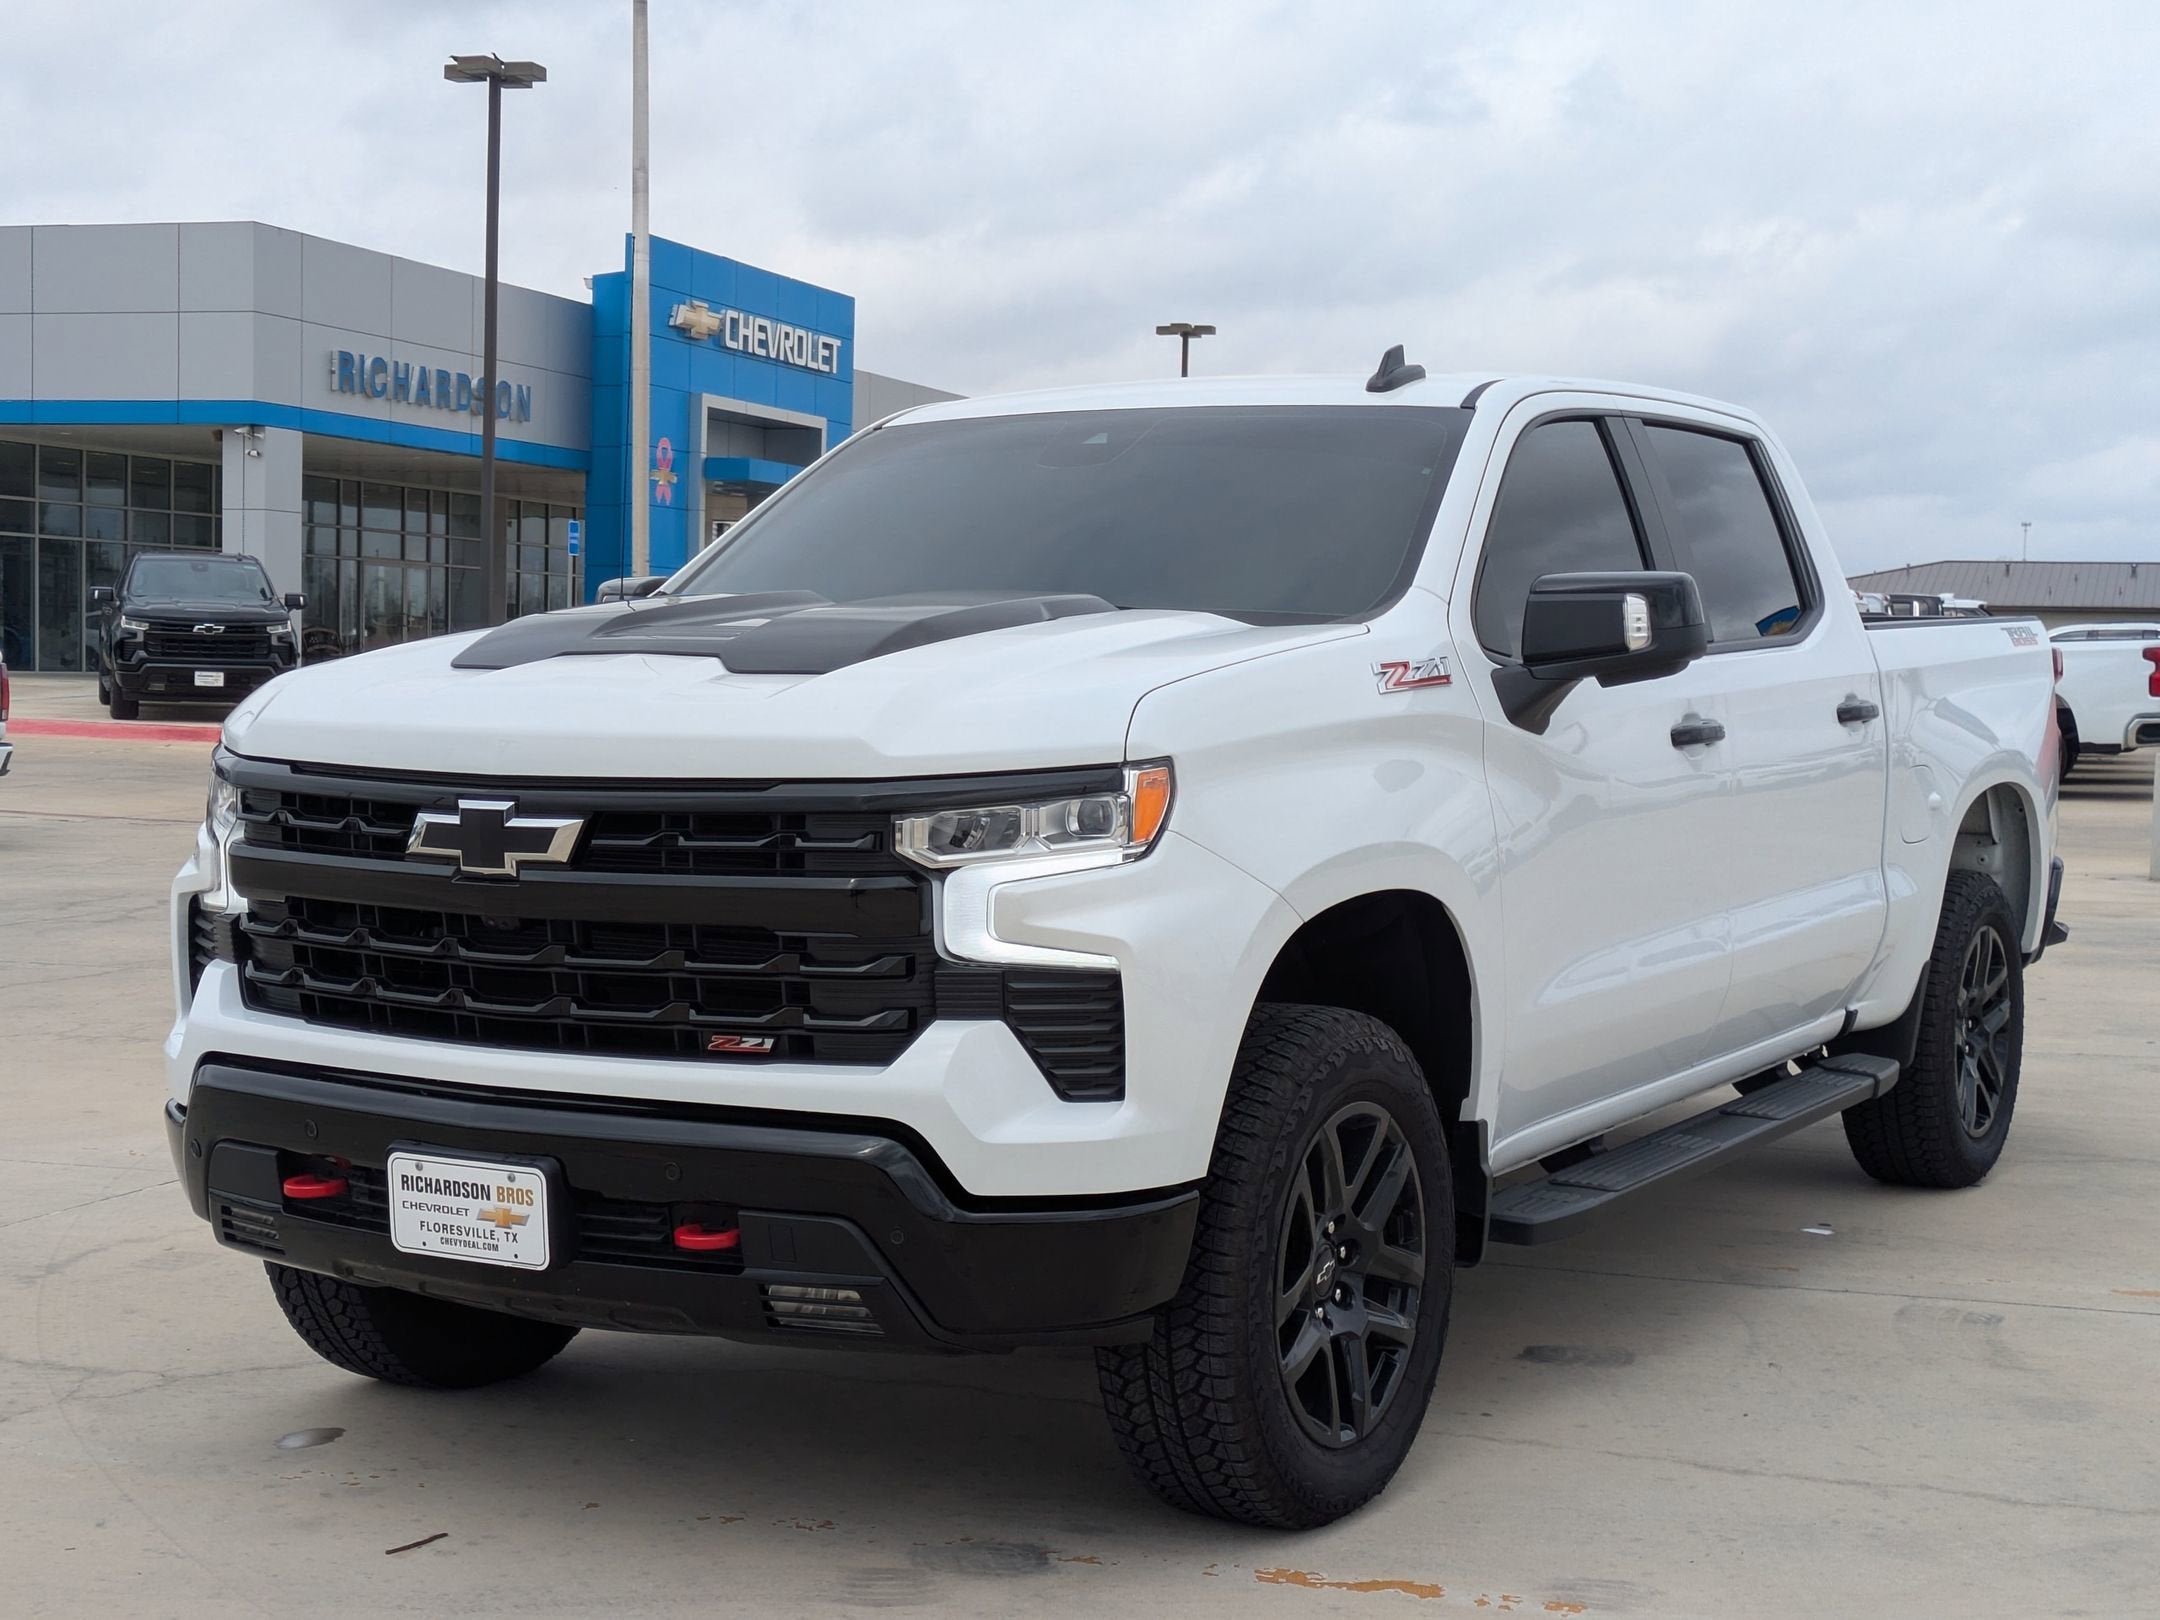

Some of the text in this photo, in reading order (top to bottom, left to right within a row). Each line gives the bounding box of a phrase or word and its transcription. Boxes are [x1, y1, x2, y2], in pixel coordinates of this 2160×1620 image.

[725, 309, 842, 374] CHEVROLET
[2000, 626, 2039, 640] TRAIL
[2011, 637, 2039, 647] BOSS
[1371, 656, 1453, 695] Z71
[708, 1035, 775, 1053] Z71
[401, 1174, 534, 1207] RICHARDSON BROS
[402, 1200, 470, 1217] CHEVROLET
[420, 1220, 519, 1244] FLORESVILLE, TX
[440, 1236, 499, 1252] CHEVYDEAL.COM
